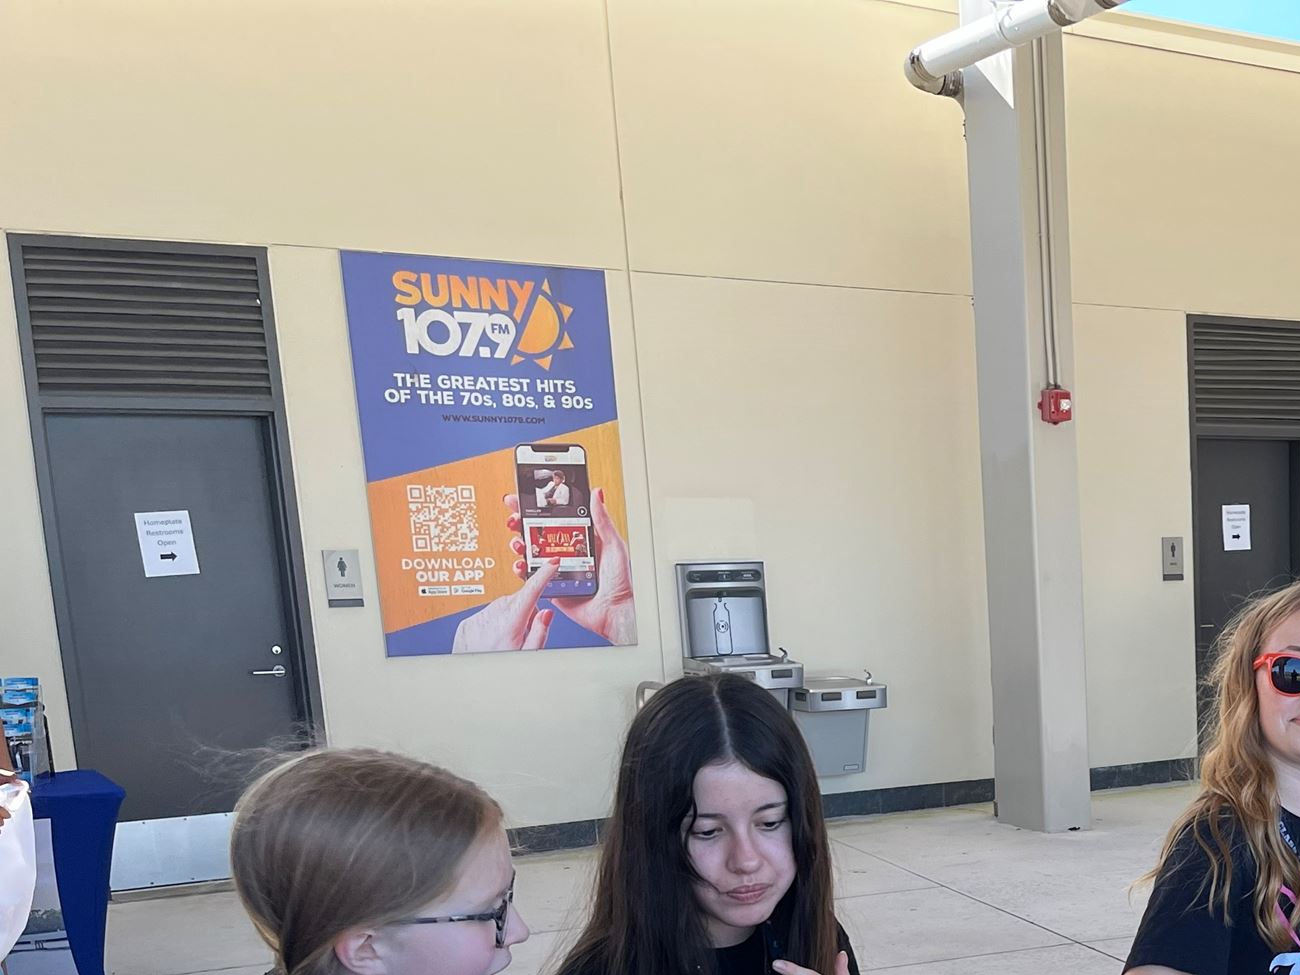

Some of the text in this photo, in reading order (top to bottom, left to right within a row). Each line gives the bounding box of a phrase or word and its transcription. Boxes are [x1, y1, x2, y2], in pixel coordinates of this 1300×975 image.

[392, 270, 535, 324] SUNNY
[396, 307, 516, 359] 107.9
[490, 323, 510, 336] FM
[392, 373, 576, 394] THE GREATEST HITS
[384, 388, 411, 403] OF
[417, 390, 455, 406] THE
[543, 395, 556, 409] &
[145, 529, 184, 538] Restrooms
[157, 539, 177, 548] Open
[401, 557, 496, 571] DOWNLOAD
[415, 570, 485, 583] OUR APP
